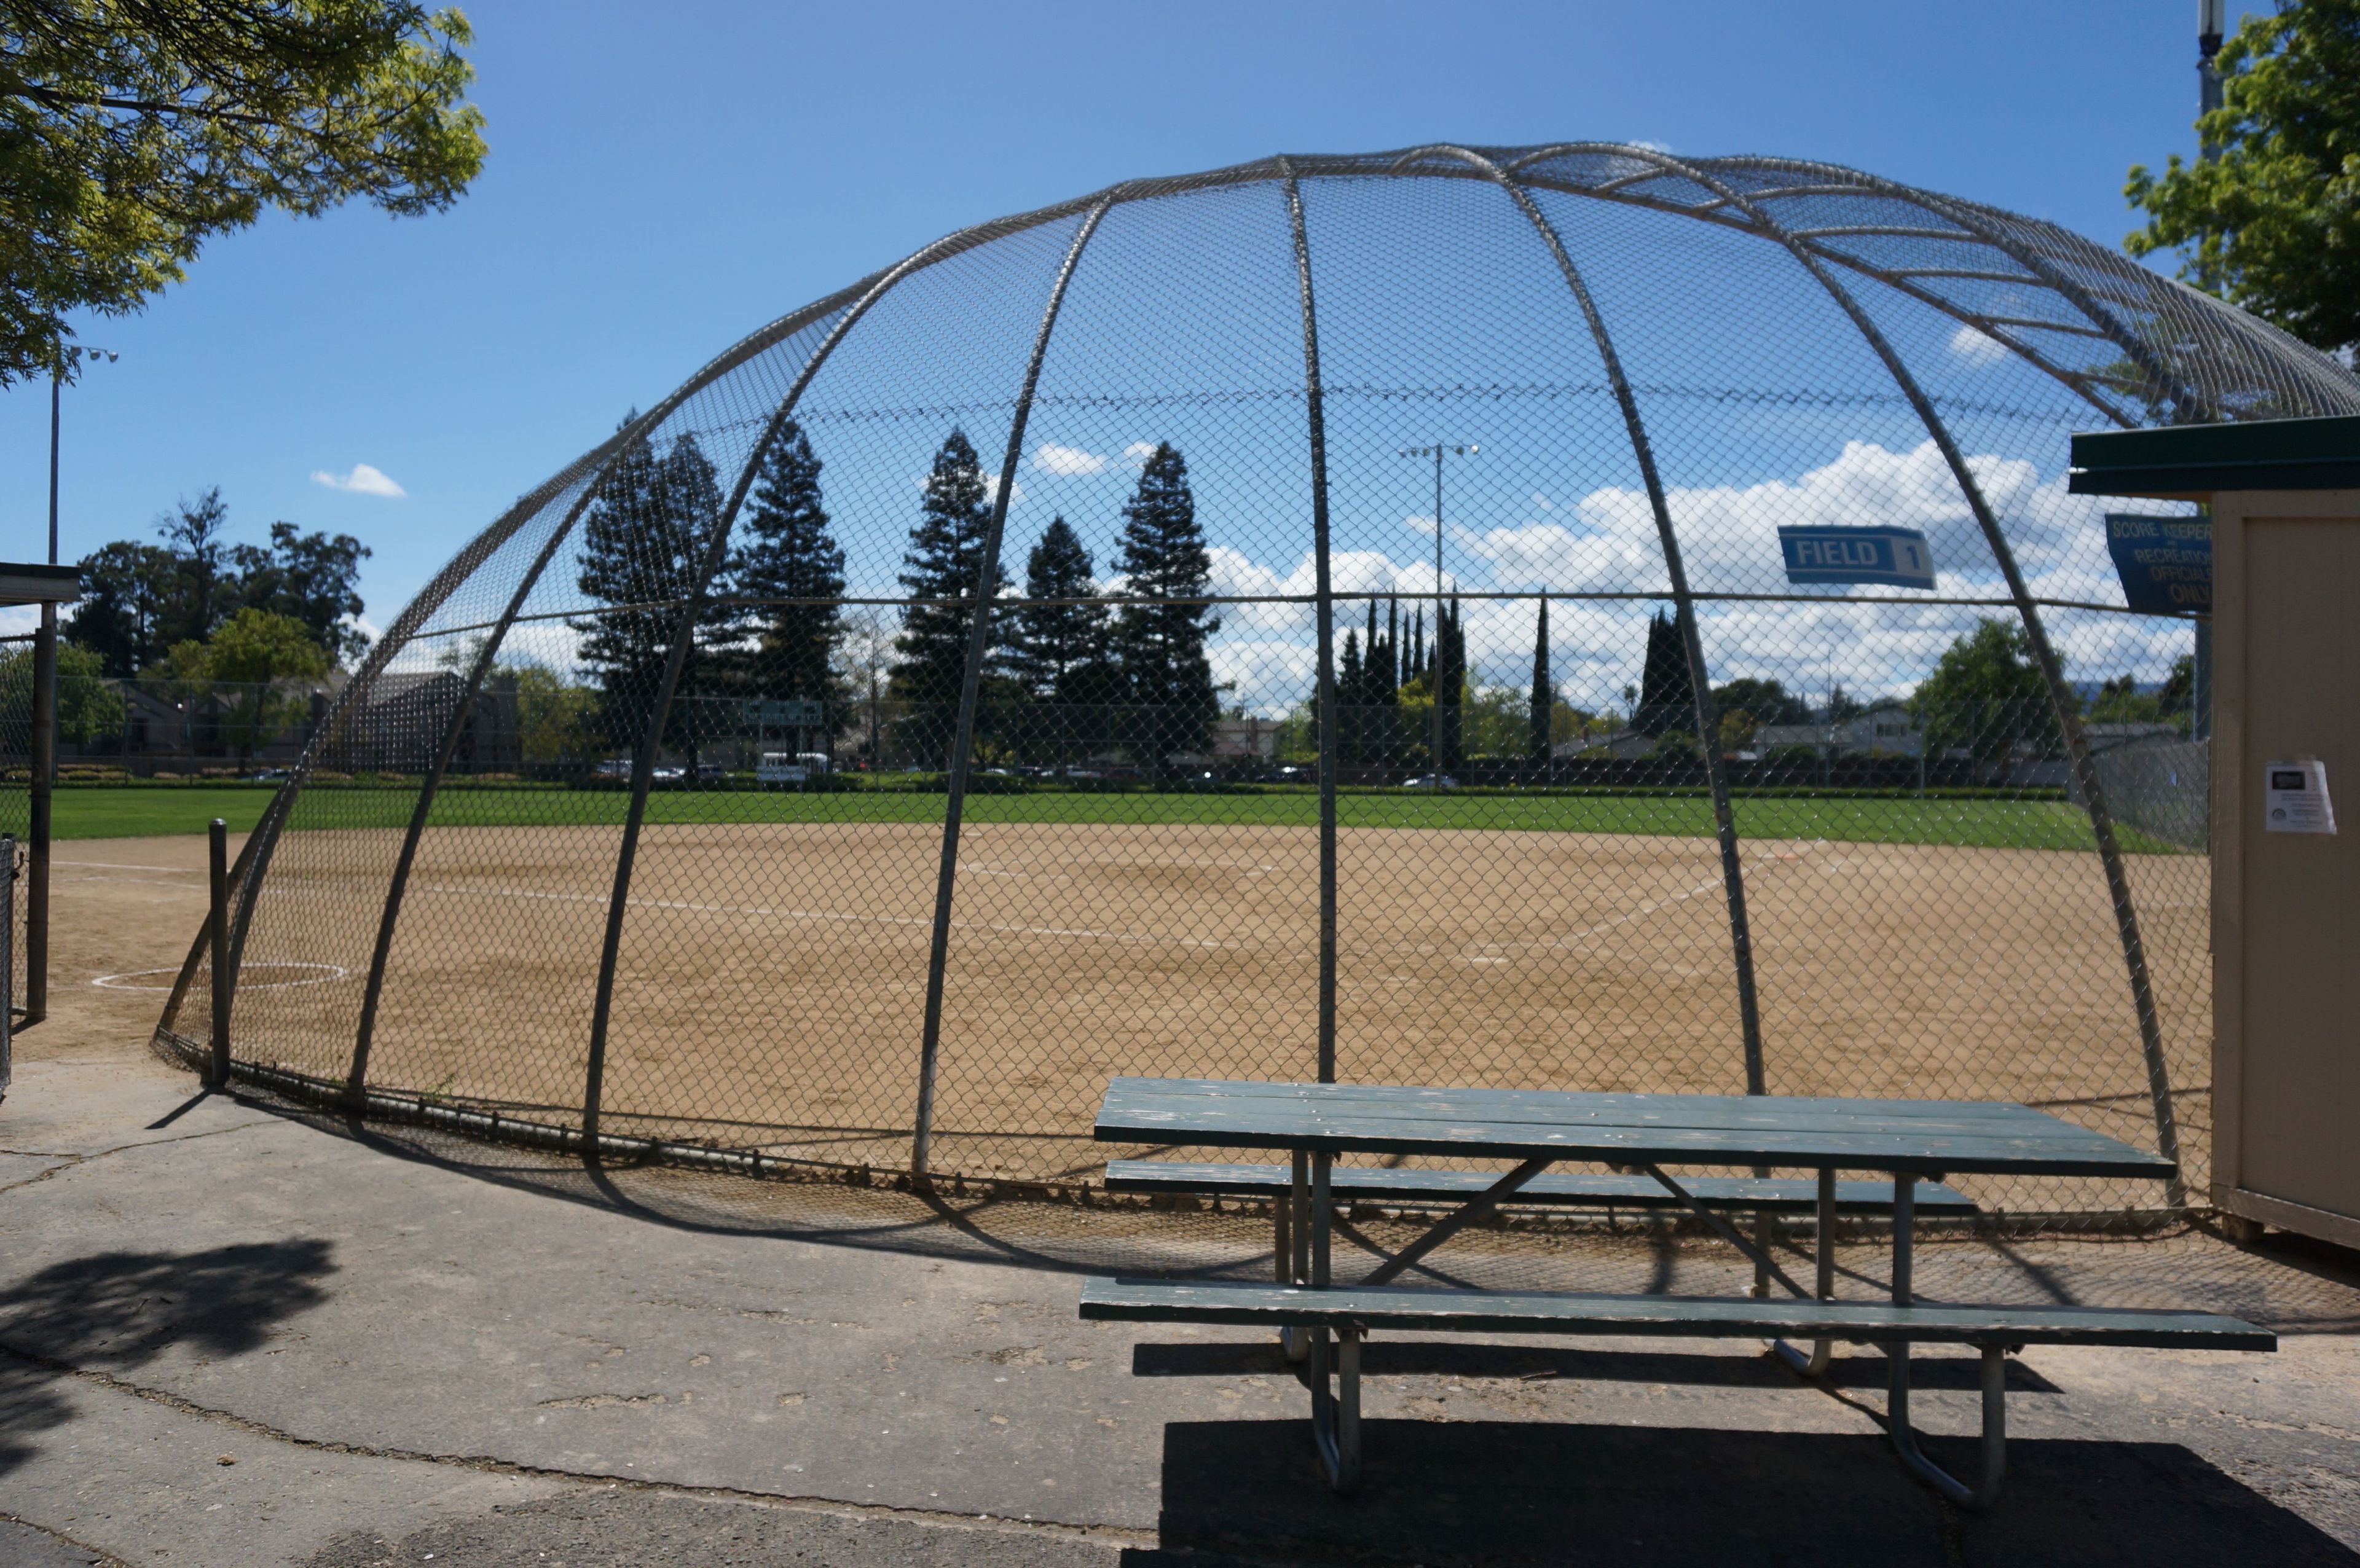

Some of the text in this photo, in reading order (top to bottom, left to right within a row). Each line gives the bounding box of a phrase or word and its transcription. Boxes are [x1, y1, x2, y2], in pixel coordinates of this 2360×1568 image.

[2114, 521, 2212, 540] SCORE KEEPER
[1796, 541, 1921, 570] FIELD 1
